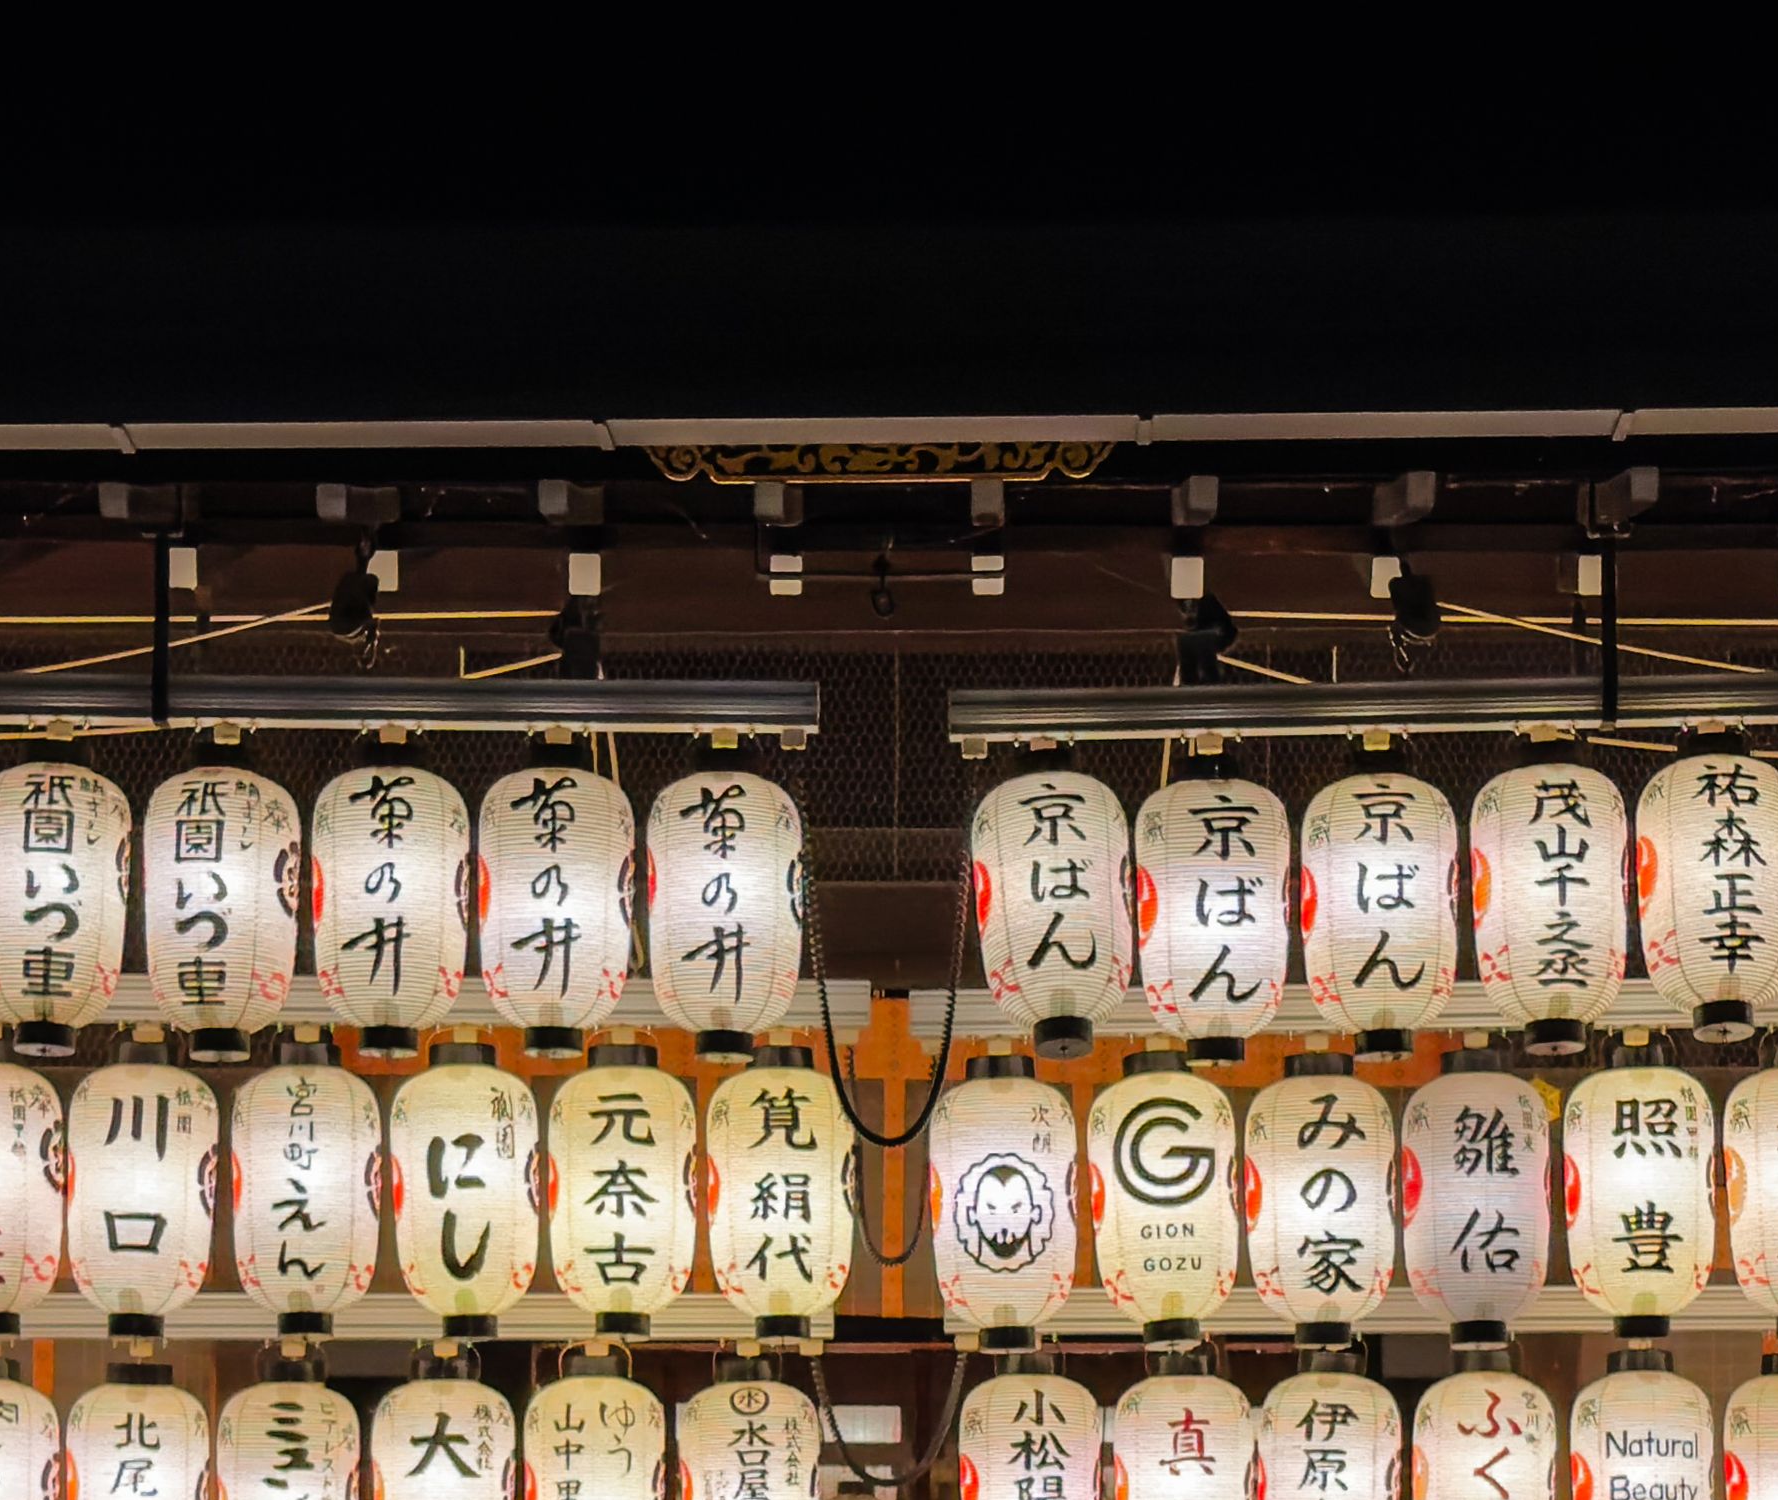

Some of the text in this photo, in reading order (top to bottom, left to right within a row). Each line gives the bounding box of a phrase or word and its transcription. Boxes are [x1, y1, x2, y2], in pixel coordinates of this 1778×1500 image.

[23, 775, 81, 996] 祇園いづ重
[175, 781, 227, 1005] 祇園いづ重
[342, 776, 414, 996] 菊乃井
[511, 777, 582, 997] 菊乃井
[681, 785, 749, 1003] 菊乃井
[1018, 782, 1096, 969] 京ばん
[1188, 795, 1262, 1002] 京ばん
[1353, 785, 1425, 989] 京ばん
[1529, 779, 1593, 987] 茂山千之丞
[1693, 764, 1766, 973] 祐森正幸
[104, 1095, 168, 1254] 川口
[175, 1088, 194, 1135] 祇園
[583, 1093, 658, 1287] 元奈古
[746, 1088, 817, 1283] 筧絹代
[1297, 1094, 1366, 1296] みの家
[1610, 1099, 1683, 1274] 照豊
[427, 1134, 490, 1281] にし
[1140, 1223, 1196, 1239] GION
[1143, 1255, 1202, 1272] GOZU
[110, 1413, 160, 1497] 北尾
[472, 1404, 495, 1471] 株式会社
[599, 1401, 636, 1476] ゆう
[783, 1417, 801, 1487] 株式会社
[1605, 1431, 1698, 1460] Natural
